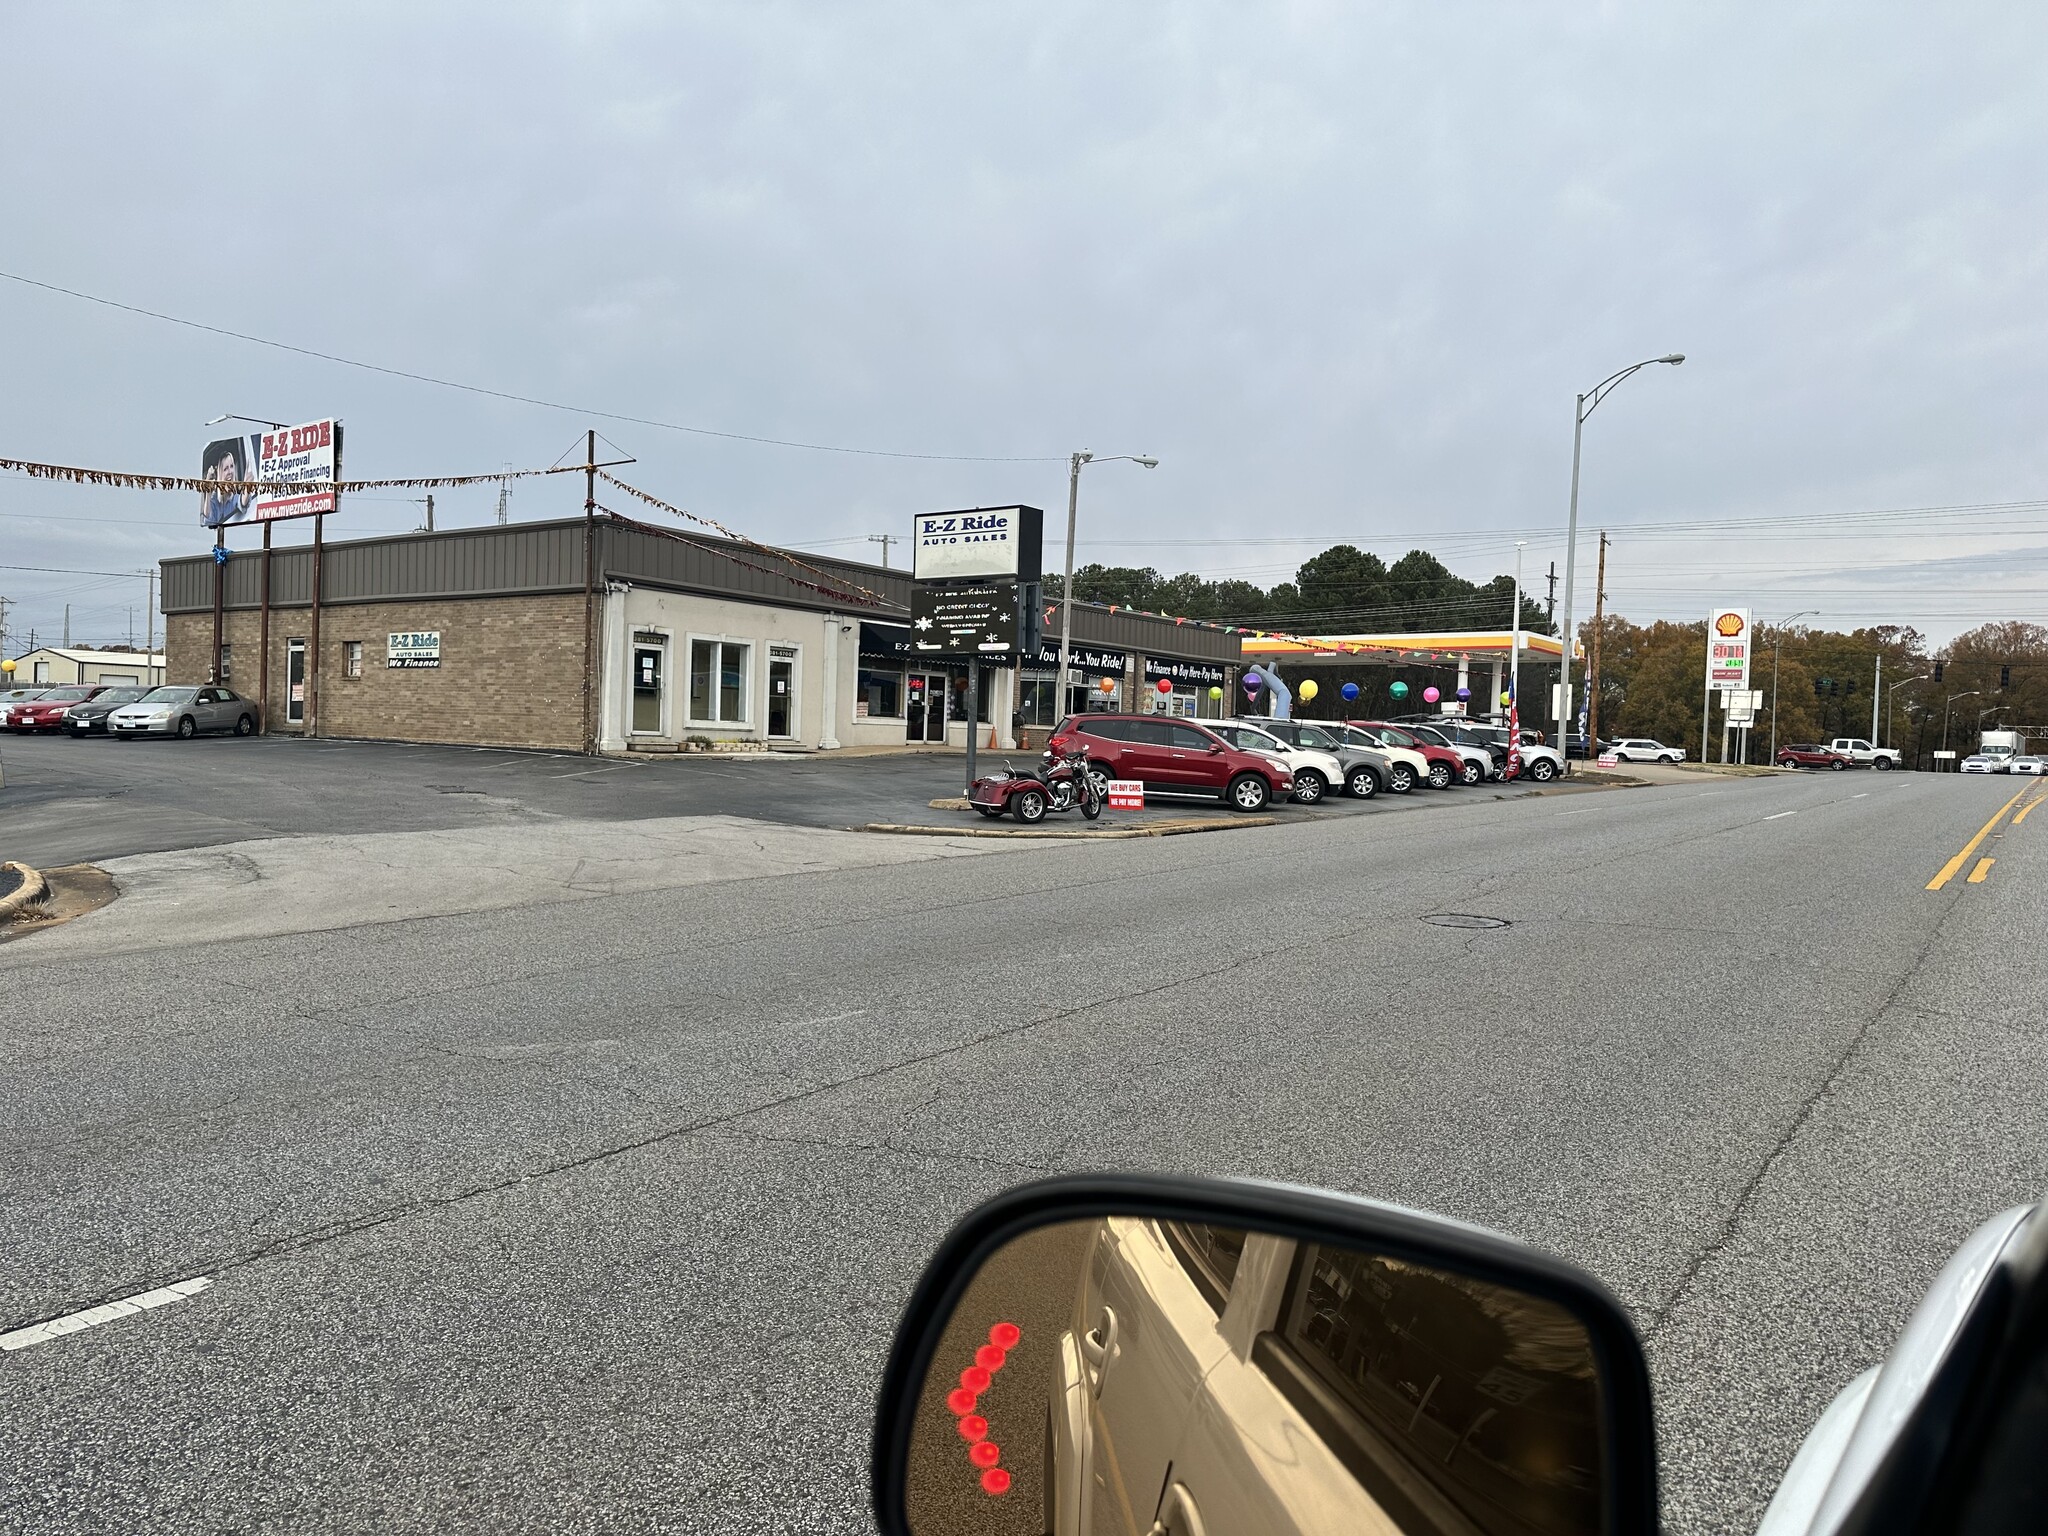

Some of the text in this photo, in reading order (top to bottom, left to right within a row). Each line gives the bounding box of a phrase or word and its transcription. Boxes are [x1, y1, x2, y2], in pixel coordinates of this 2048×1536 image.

[262, 420, 330, 460] E-Z RIDE
[264, 452, 310, 473] E-Z Approval
[276, 471, 299, 483] Chance
[300, 464, 330, 480] Financing
[258, 498, 331, 519] www.myezride.com
[923, 515, 1008, 533] E-Z Ride
[923, 534, 1007, 546] AUTO SALES
[391, 633, 439, 647] E-Z Ride
[895, 642, 910, 650] E-Z
[389, 659, 439, 667] We Finance
[1101, 654, 1124, 670] Ride!
[1146, 660, 1153, 672] We
[1153, 661, 1171, 675] Finance
[1179, 664, 1189, 680] Buy
[1211, 668, 1223, 680] Here
[1110, 783, 1142, 792] WE BUY CARS
